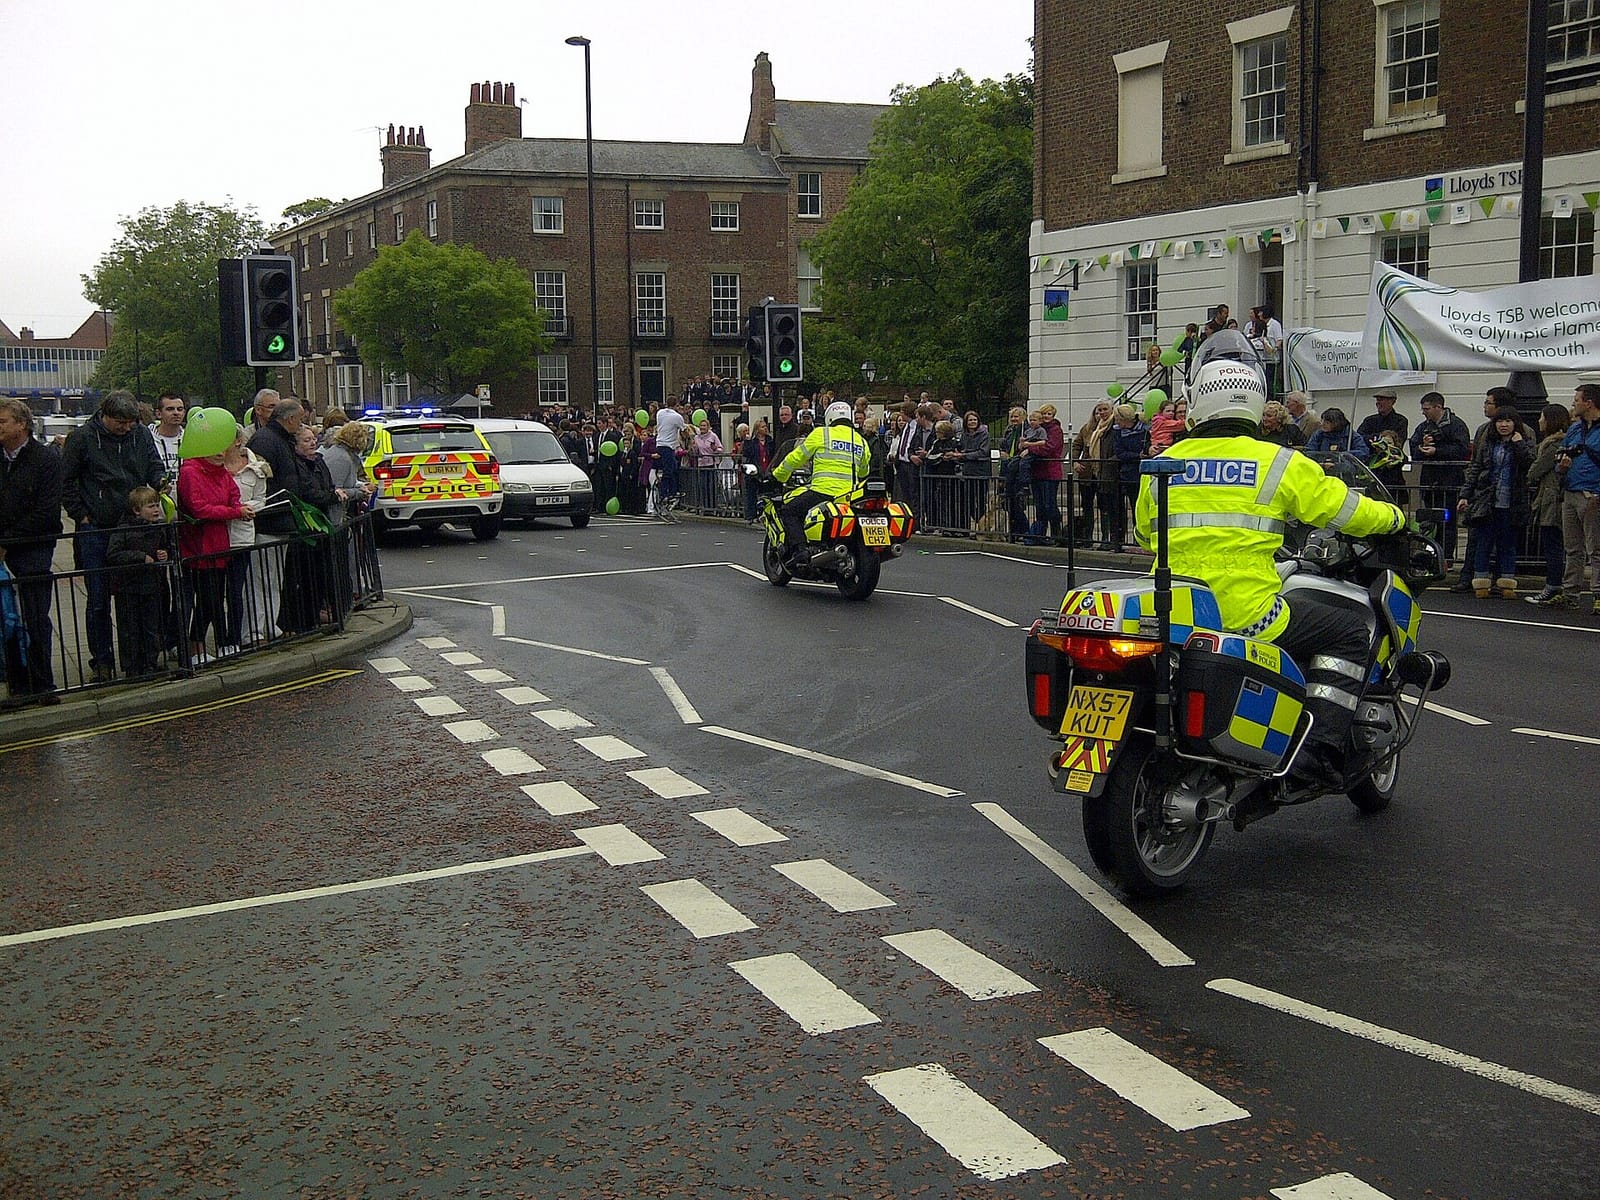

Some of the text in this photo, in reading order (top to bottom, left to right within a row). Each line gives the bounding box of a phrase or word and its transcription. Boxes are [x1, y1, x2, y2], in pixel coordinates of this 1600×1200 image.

[1450, 173, 1495, 195] Lloyds
[1440, 300, 1600, 324] Lloyds TSB welcom
[1315, 350, 1358, 363] the Olympic
[1219, 367, 1254, 377] POLICE
[1323, 365, 1331, 374] to
[1168, 461, 1256, 484] OLICE
[401, 483, 487, 495] POLICE
[1058, 616, 1114, 631] POLICE
[1258, 655, 1277, 669] POLICE
[1070, 690, 1131, 715] NX57
[1070, 712, 1116, 736] KUT
